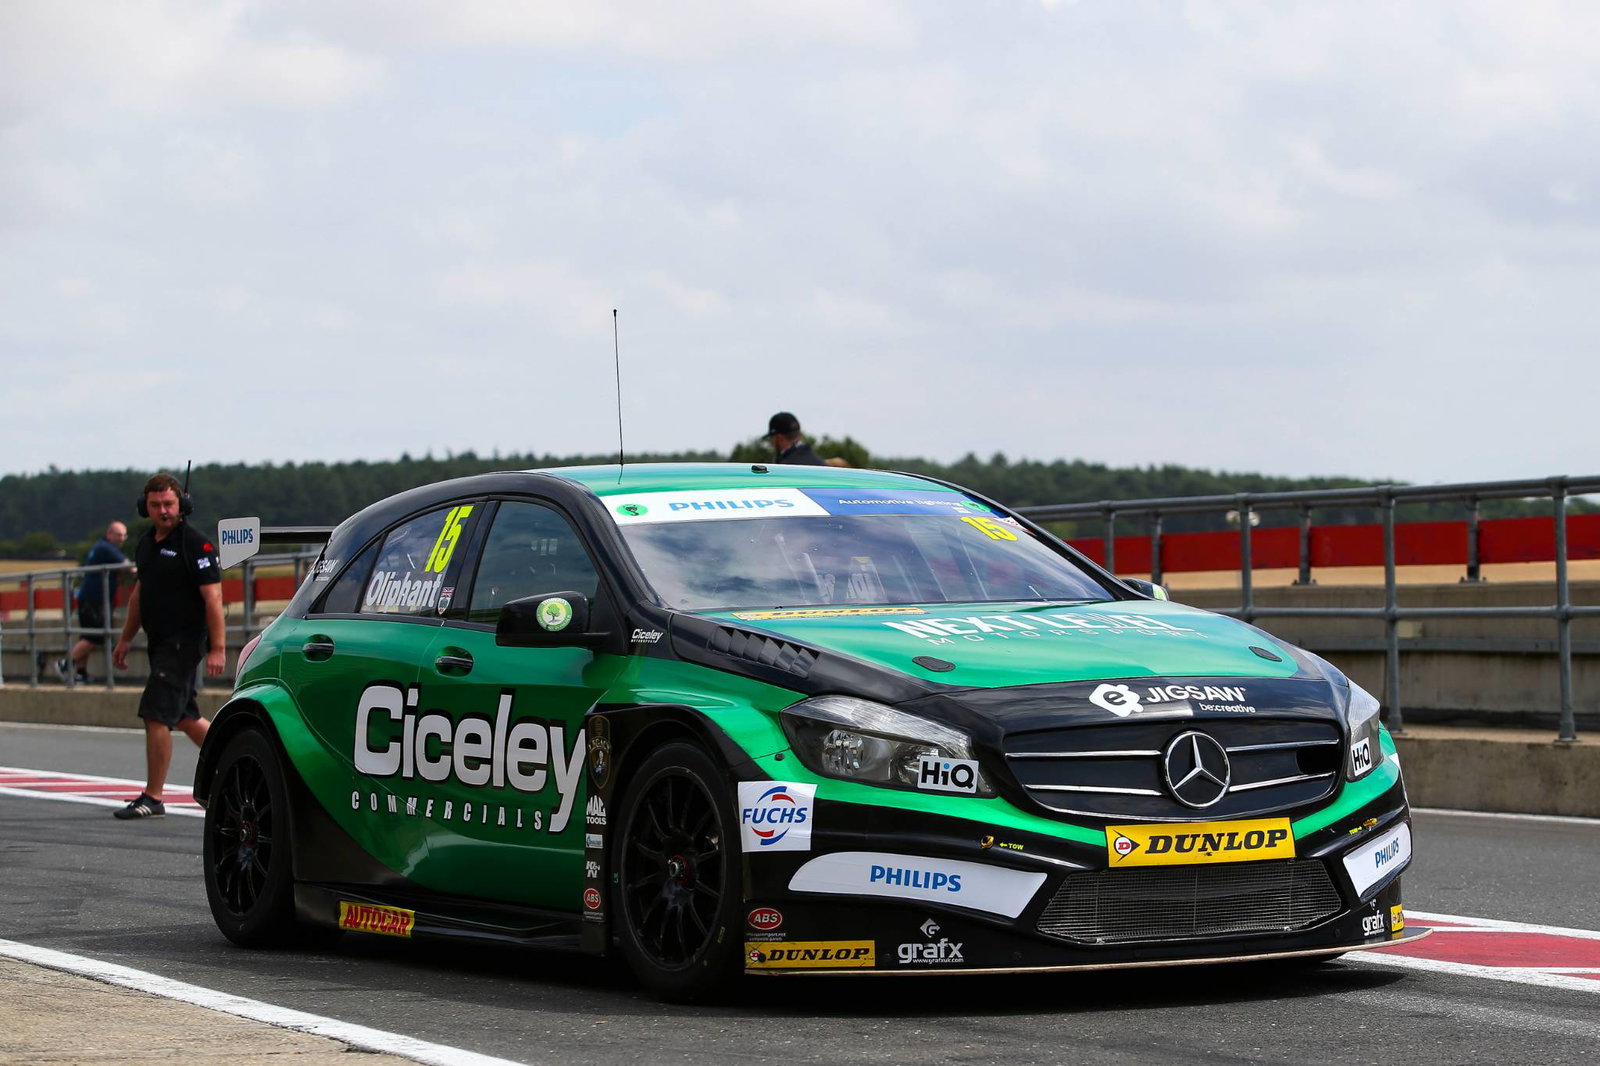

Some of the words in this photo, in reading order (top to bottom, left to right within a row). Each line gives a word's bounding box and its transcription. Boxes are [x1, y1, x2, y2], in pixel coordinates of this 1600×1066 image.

[668, 499, 795, 511] PHILIPS
[222, 528, 254, 545] PHILIPS
[425, 505, 474, 573] 15
[961, 516, 1018, 541] 15
[366, 571, 443, 613] Oliphant
[632, 628, 664, 643] Ciceley
[881, 613, 1037, 639] NEXT
[1020, 612, 1195, 632] LEVEL
[927, 623, 1210, 646] MOTORSPORT
[1146, 685, 1246, 703] JIGSAW
[354, 685, 587, 833] Ciceley
[1353, 743, 1371, 771] HiQ
[921, 761, 974, 789] HiQ
[351, 791, 542, 831] COMMERCIALS
[586, 795, 606, 816] MAC
[743, 807, 807, 824] FUCHS
[586, 816, 607, 825] TOOLS
[1008, 842, 1024, 850] TOW
[1145, 829, 1288, 854] DUNLOP
[1374, 838, 1400, 868] PHILIPS
[870, 865, 961, 893] PHILIPS
[586, 893, 599, 903] ABS
[343, 905, 411, 936] AUTOCAR
[753, 913, 778, 923] ABS
[1362, 910, 1385, 936] grafx
[767, 948, 870, 961] DUNLOP
[898, 938, 963, 964] grafx
